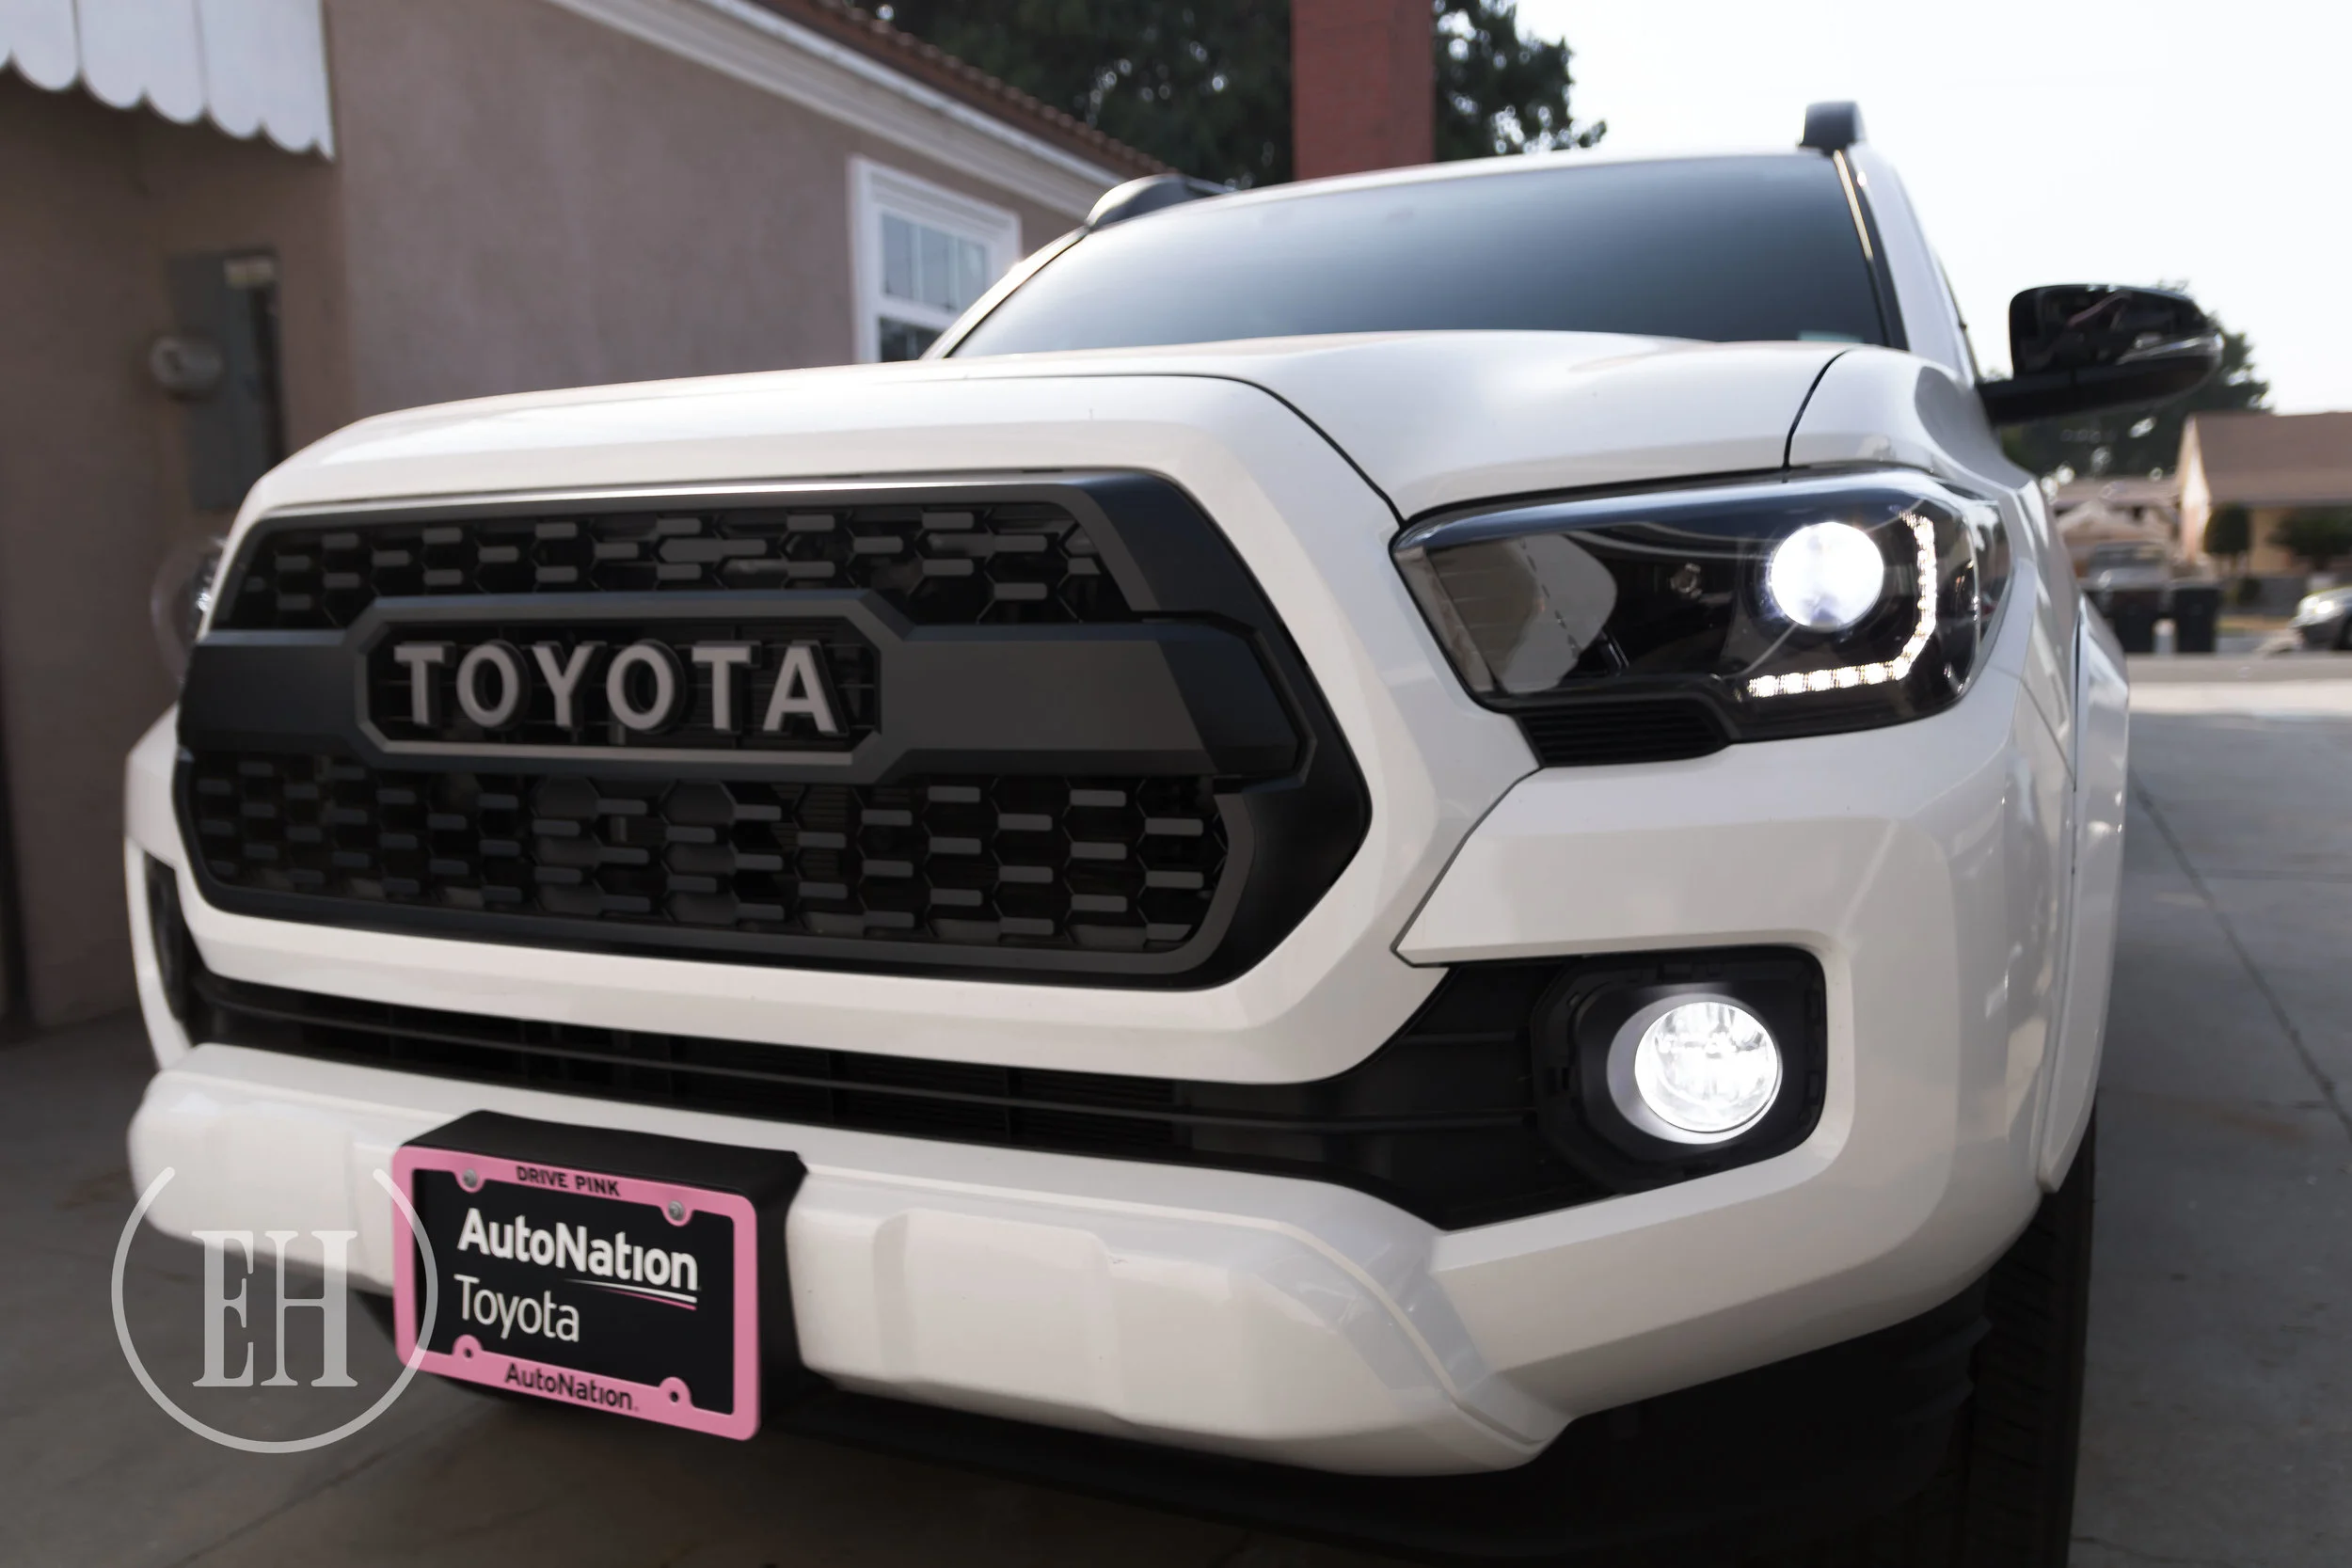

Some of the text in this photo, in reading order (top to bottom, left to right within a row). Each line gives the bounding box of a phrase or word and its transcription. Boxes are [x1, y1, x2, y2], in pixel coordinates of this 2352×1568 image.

[393, 641, 840, 734] TOYOTA
[516, 1165, 621, 1197] DRIVE PINK
[457, 1207, 698, 1291] AutoNation
[453, 1273, 580, 1343] Toyota
[504, 1362, 634, 1411] AutoNation
